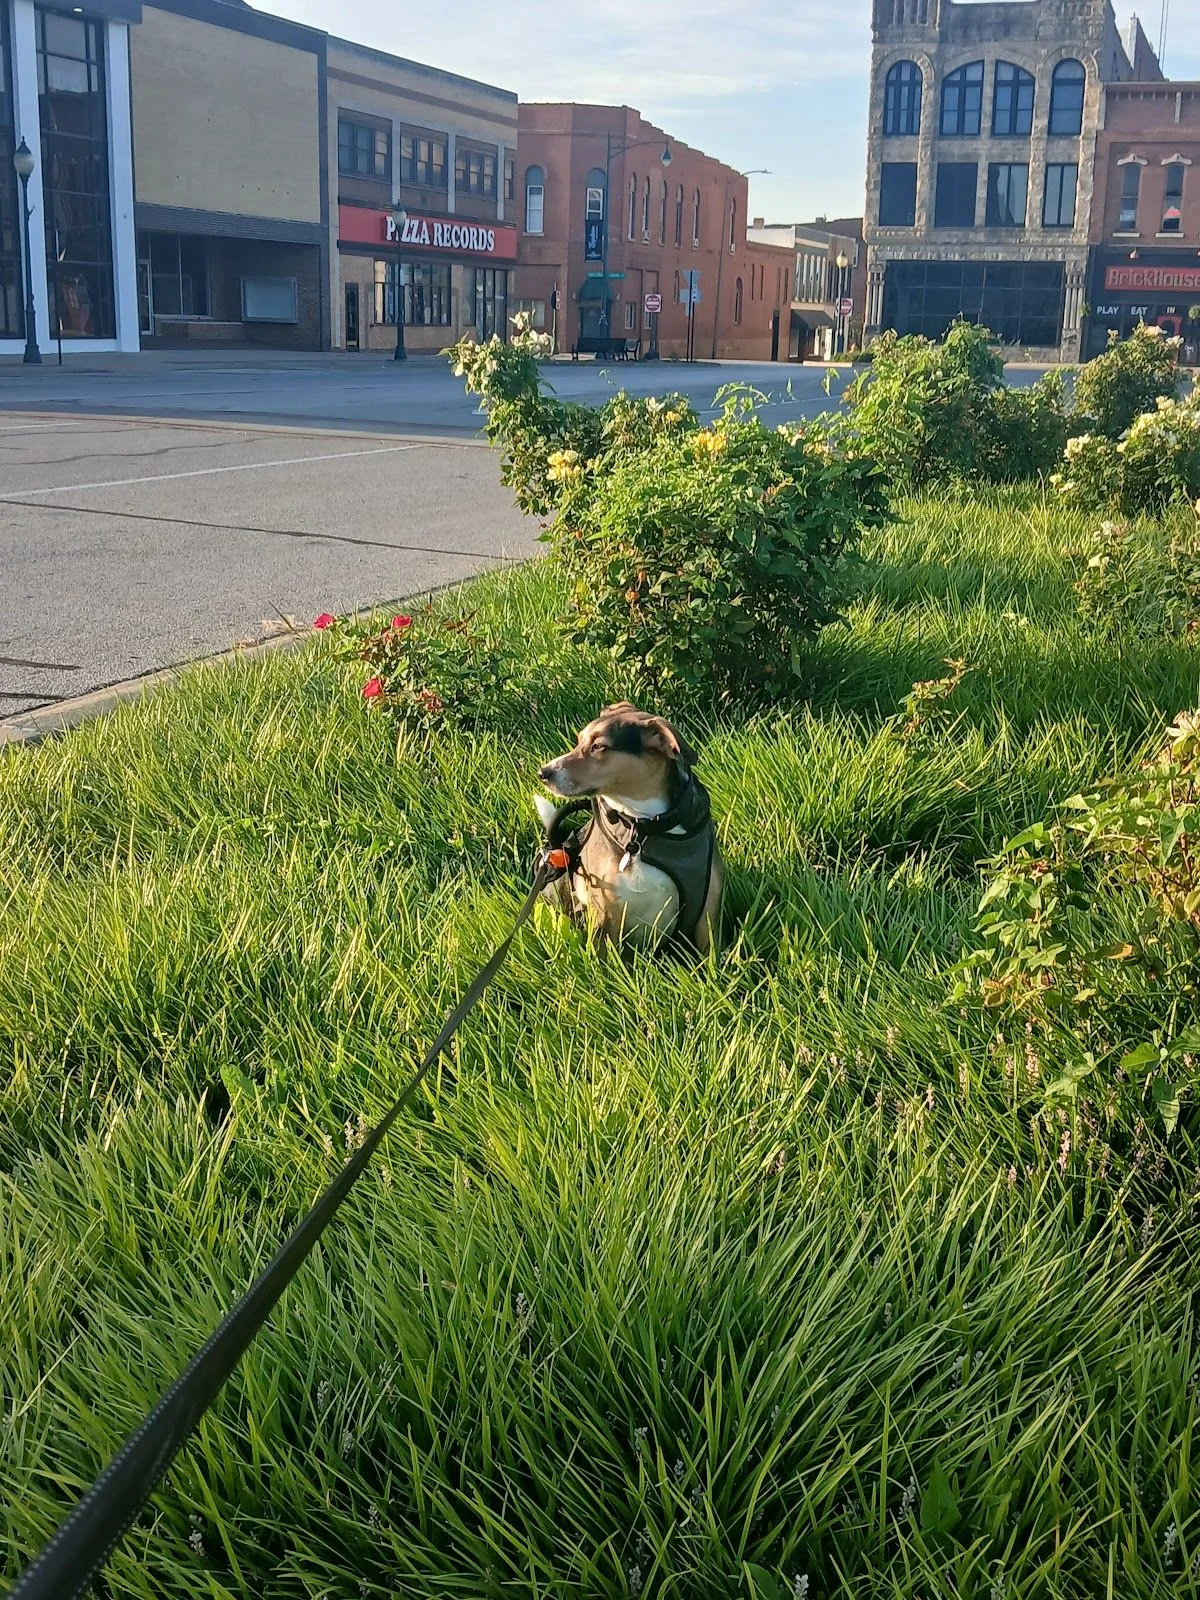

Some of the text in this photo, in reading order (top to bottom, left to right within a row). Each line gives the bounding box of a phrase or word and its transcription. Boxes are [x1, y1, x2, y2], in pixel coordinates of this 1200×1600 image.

[433, 222, 495, 252] RECORDS
[1096, 306, 1176, 315] PLAY EAT IN
